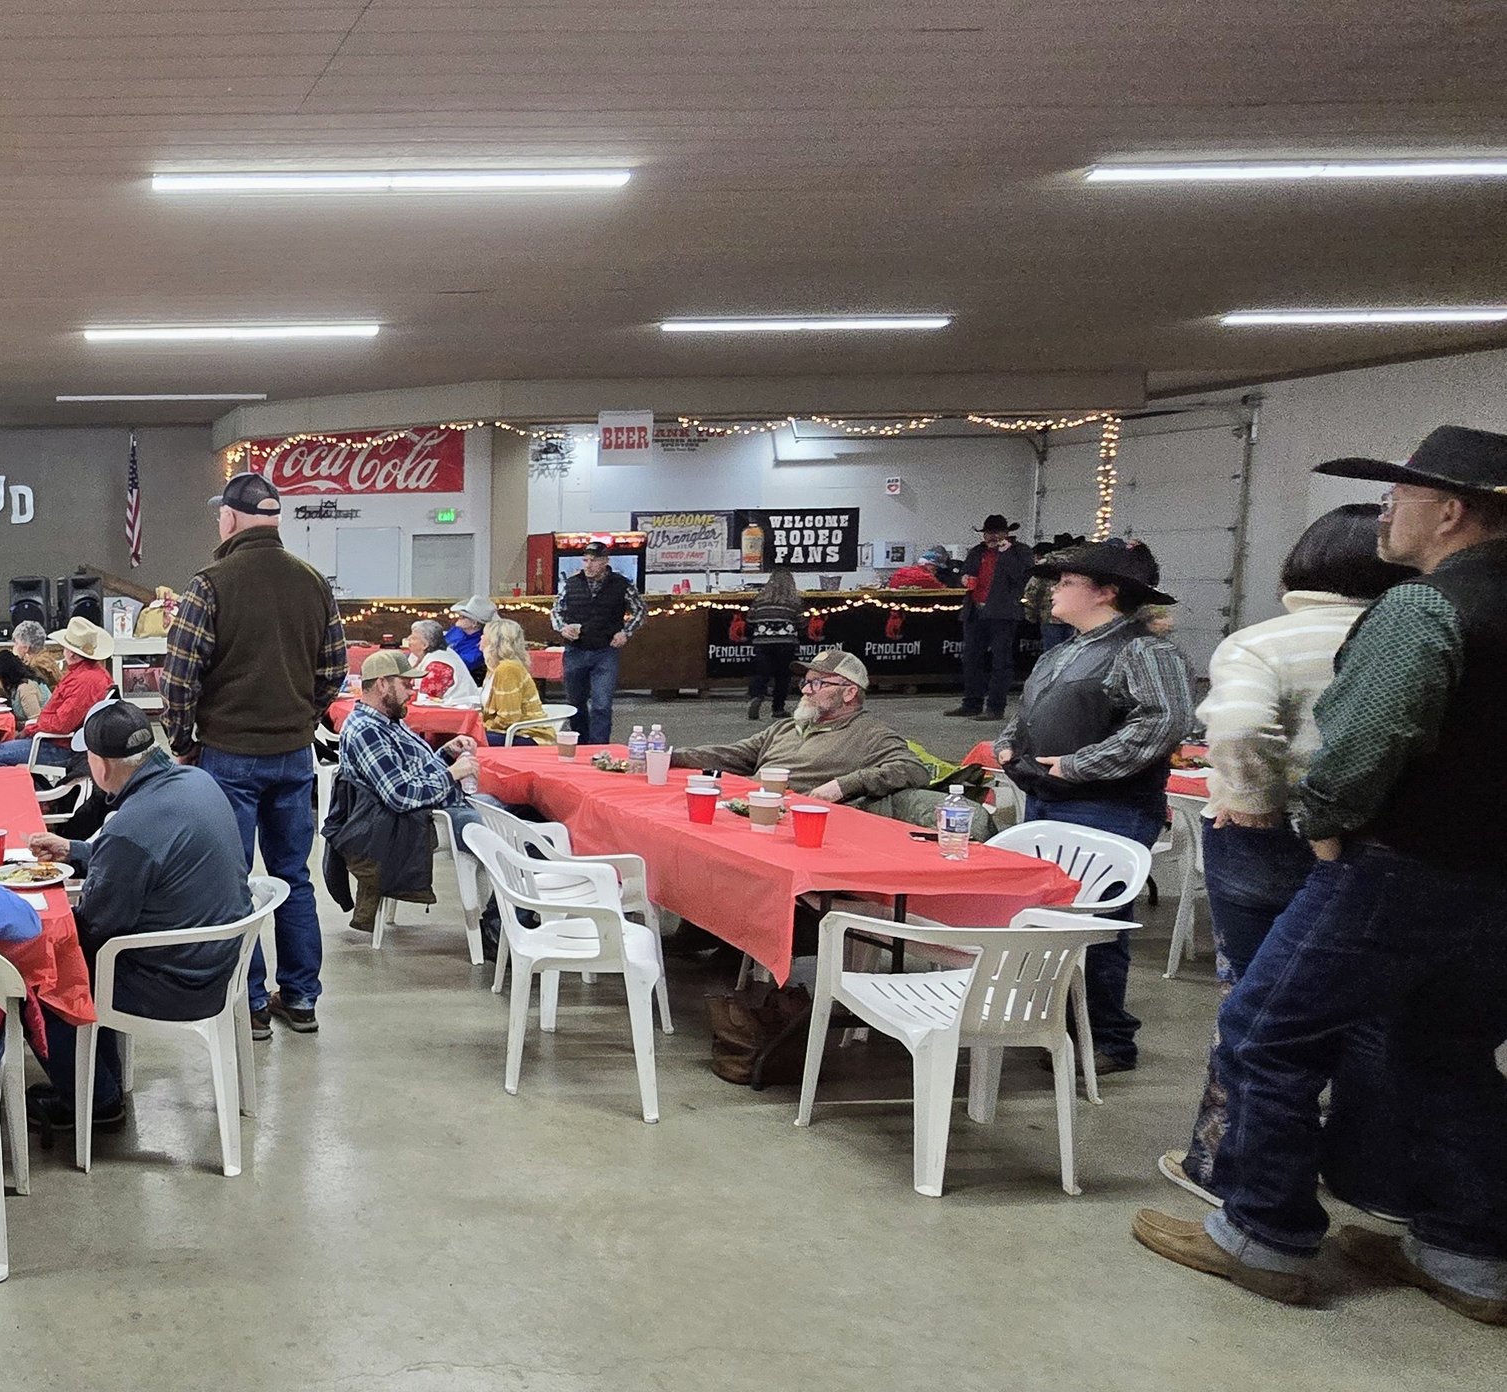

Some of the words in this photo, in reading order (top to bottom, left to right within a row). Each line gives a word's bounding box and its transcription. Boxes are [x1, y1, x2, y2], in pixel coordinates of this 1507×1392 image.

[601, 426, 650, 450] BEER
[653, 514, 716, 528] WELCOME
[769, 515, 849, 529] WELCOME
[647, 525, 723, 550] Wrangler
[773, 529, 843, 546] RODEO
[660, 550, 684, 560] RODEO
[774, 546, 840, 564] FANS
[708, 644, 756, 659] PENDLETO
[865, 641, 921, 656] PENDLETON
